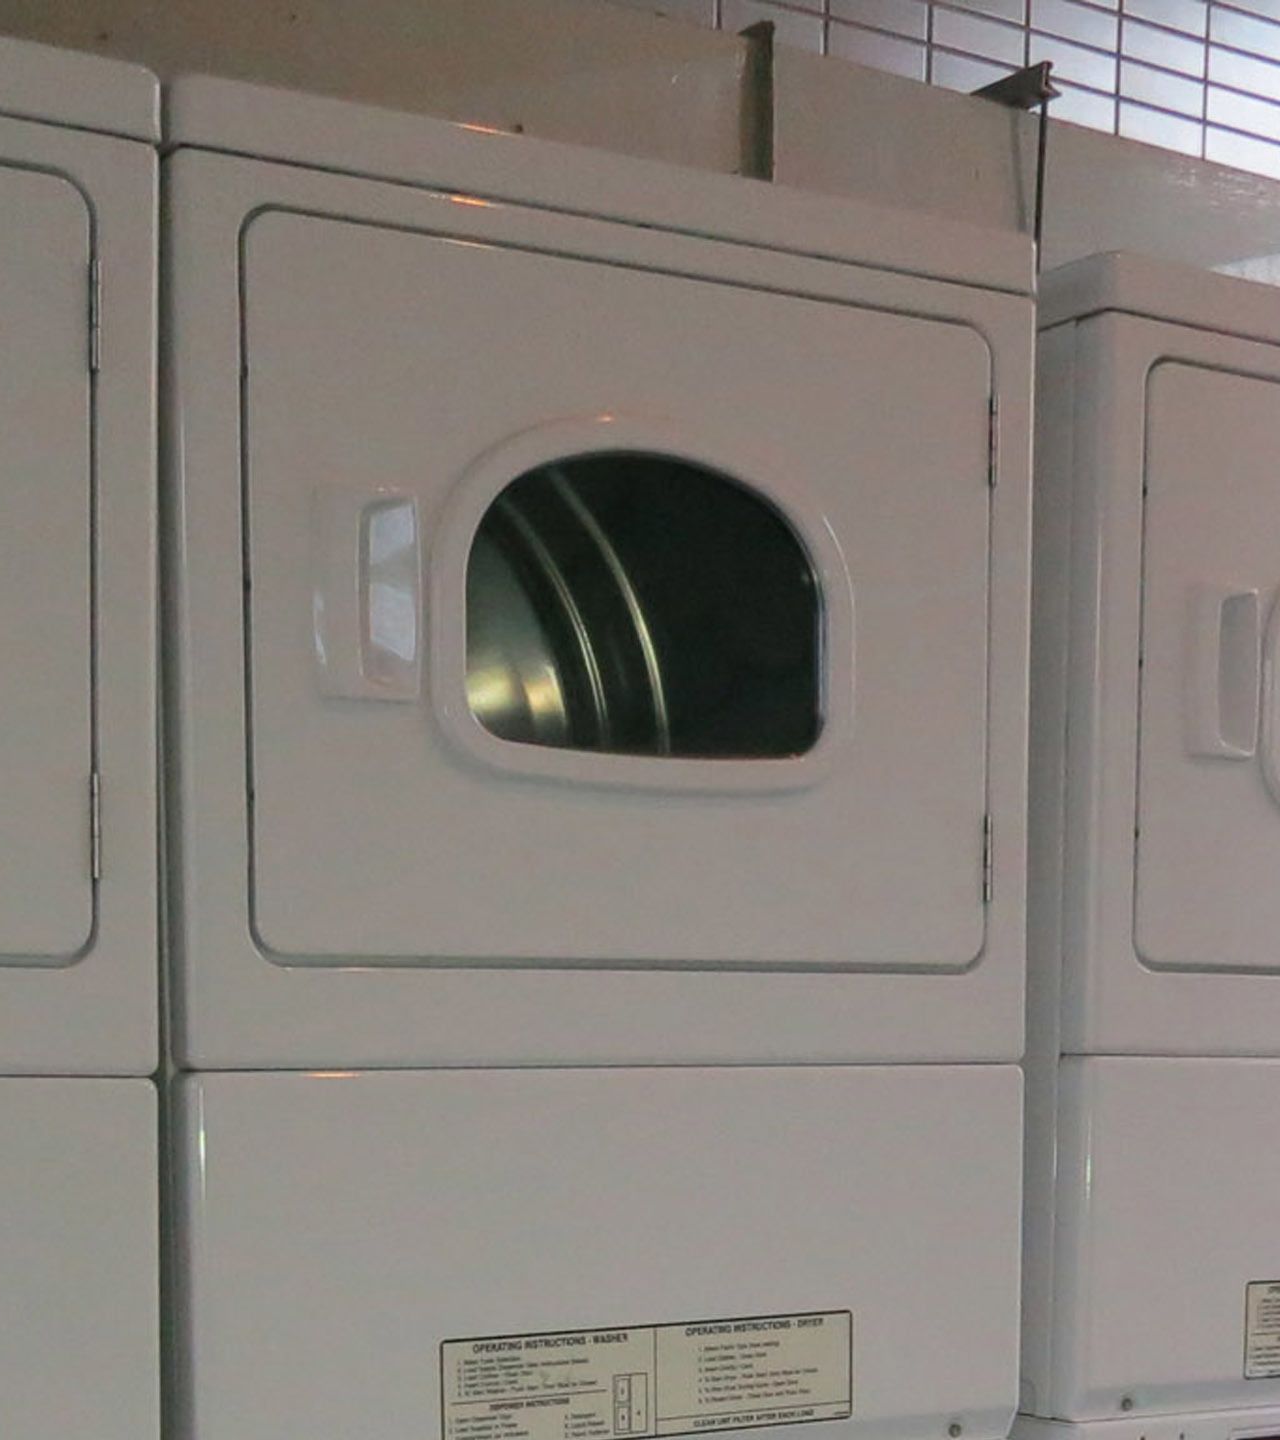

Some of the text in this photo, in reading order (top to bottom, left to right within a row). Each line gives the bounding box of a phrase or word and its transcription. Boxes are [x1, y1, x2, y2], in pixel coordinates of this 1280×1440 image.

[685, 1325, 732, 1336] OPERATING
[734, 1321, 791, 1332] INSTRUCTIONS
[797, 1318, 824, 1328] DRYER
[472, 1341, 522, 1354] OPERATING
[524, 1336, 586, 1349] INSTRUCTIONS
[593, 1333, 628, 1344] WASHER
